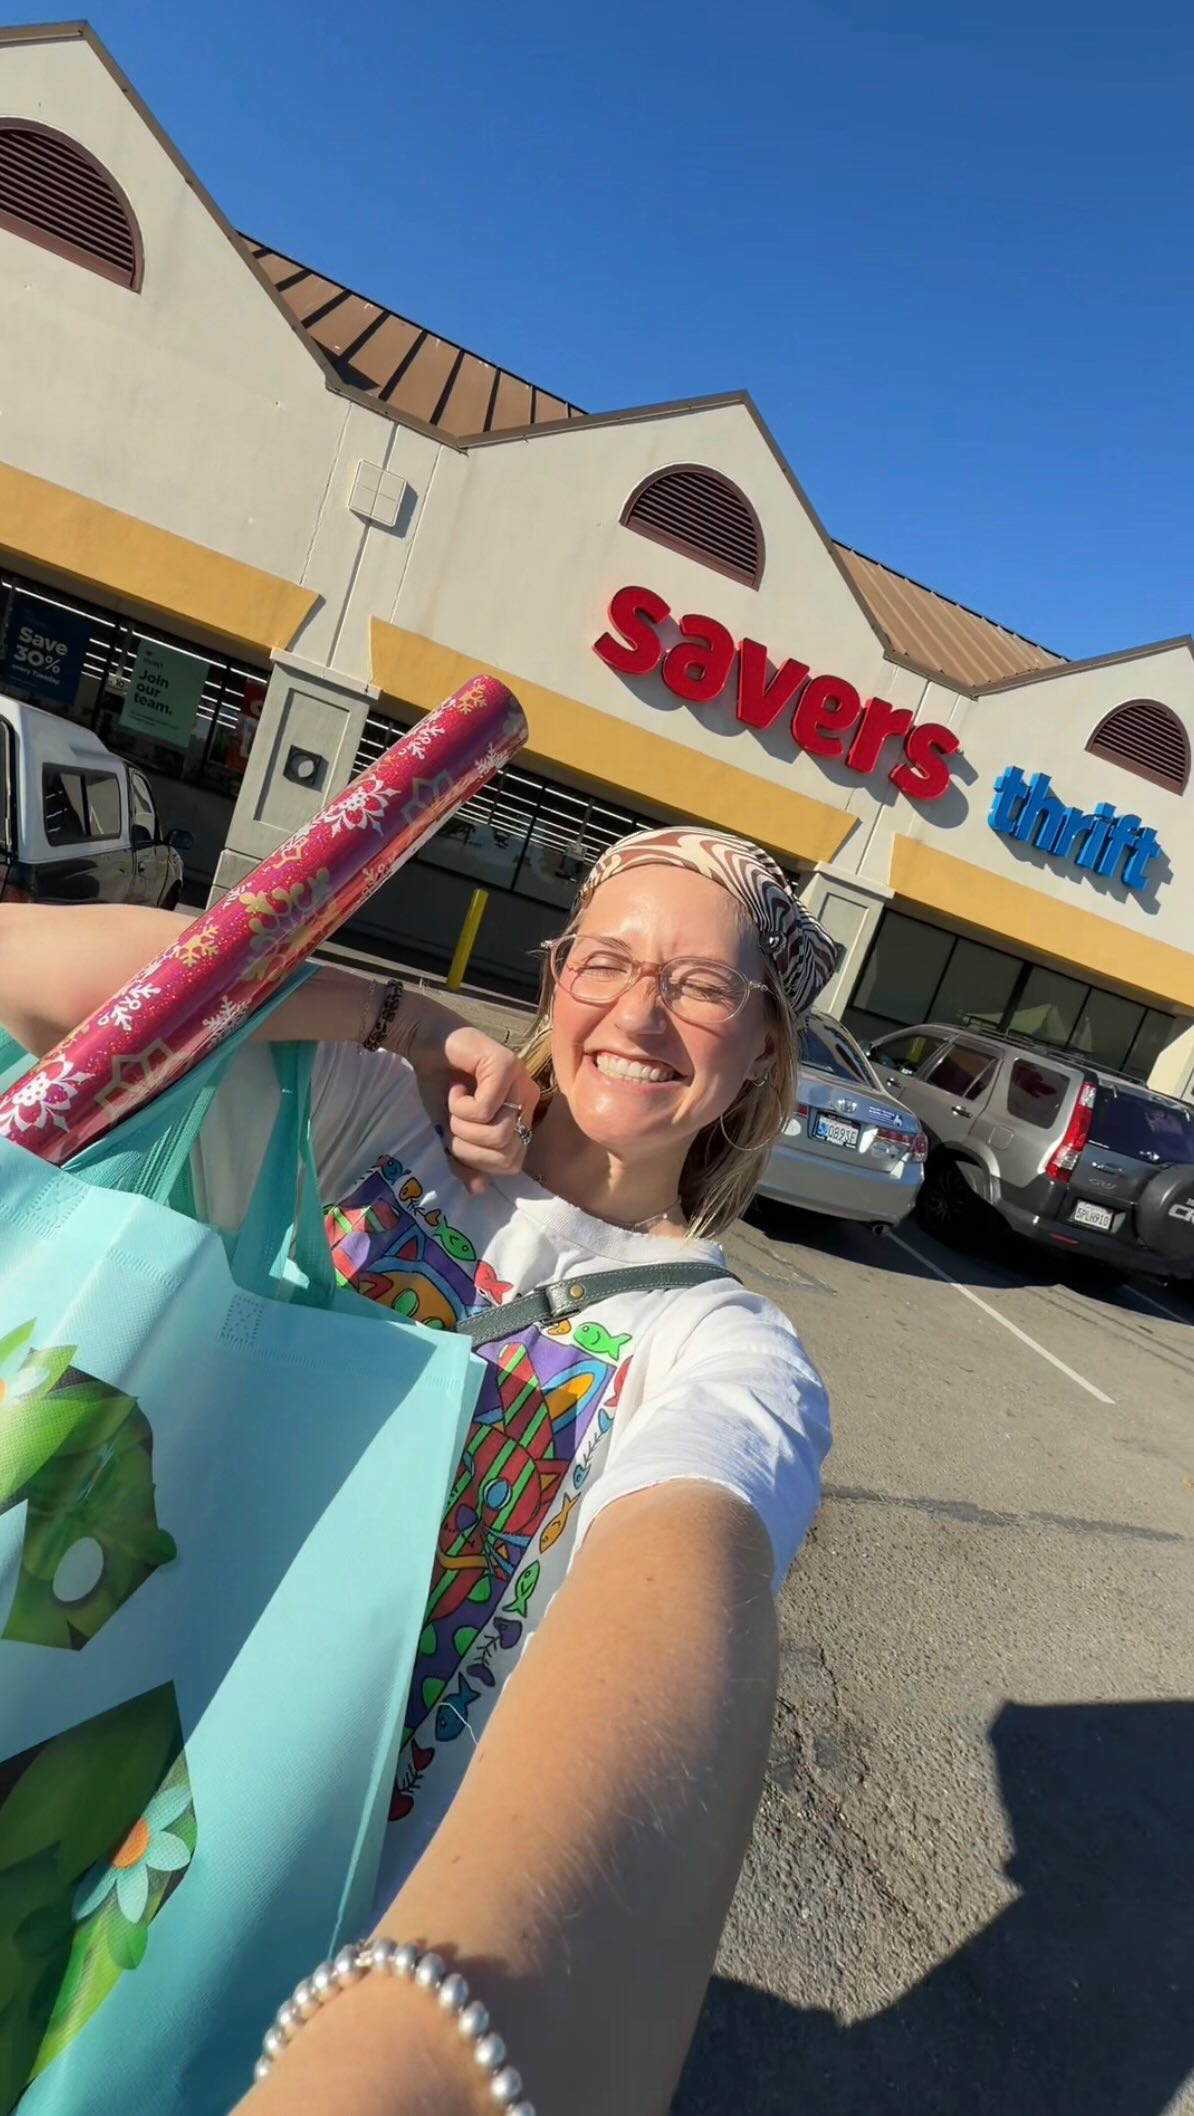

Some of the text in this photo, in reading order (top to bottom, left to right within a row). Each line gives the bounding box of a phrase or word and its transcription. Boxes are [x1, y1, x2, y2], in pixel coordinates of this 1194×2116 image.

[18, 626, 69, 657] Save
[13, 644, 61, 674] 30%
[136, 683, 161, 698] our
[139, 670, 169, 689] Join
[134, 693, 173, 716] team.
[593, 585, 1161, 891] savers thrift
